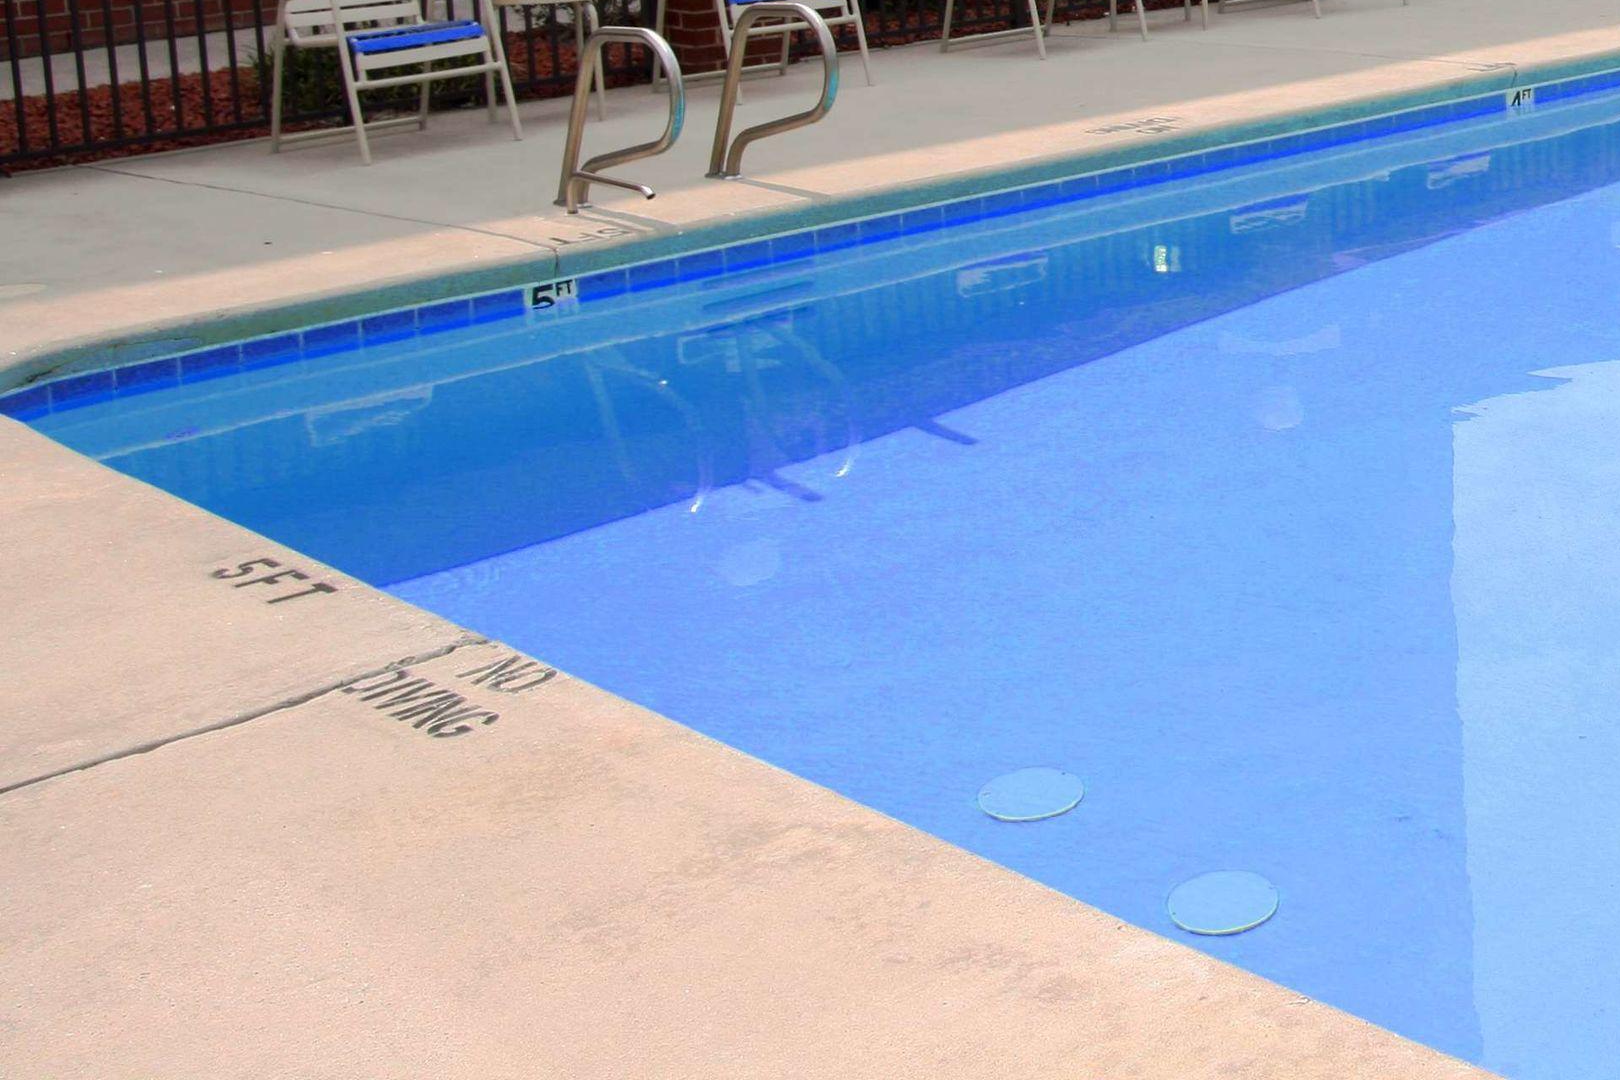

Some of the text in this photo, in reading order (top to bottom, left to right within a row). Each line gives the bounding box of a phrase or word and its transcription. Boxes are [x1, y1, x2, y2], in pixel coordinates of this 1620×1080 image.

[211, 558, 338, 605] 5FT
[455, 655, 557, 693] NO
[341, 669, 500, 738] DIVING
